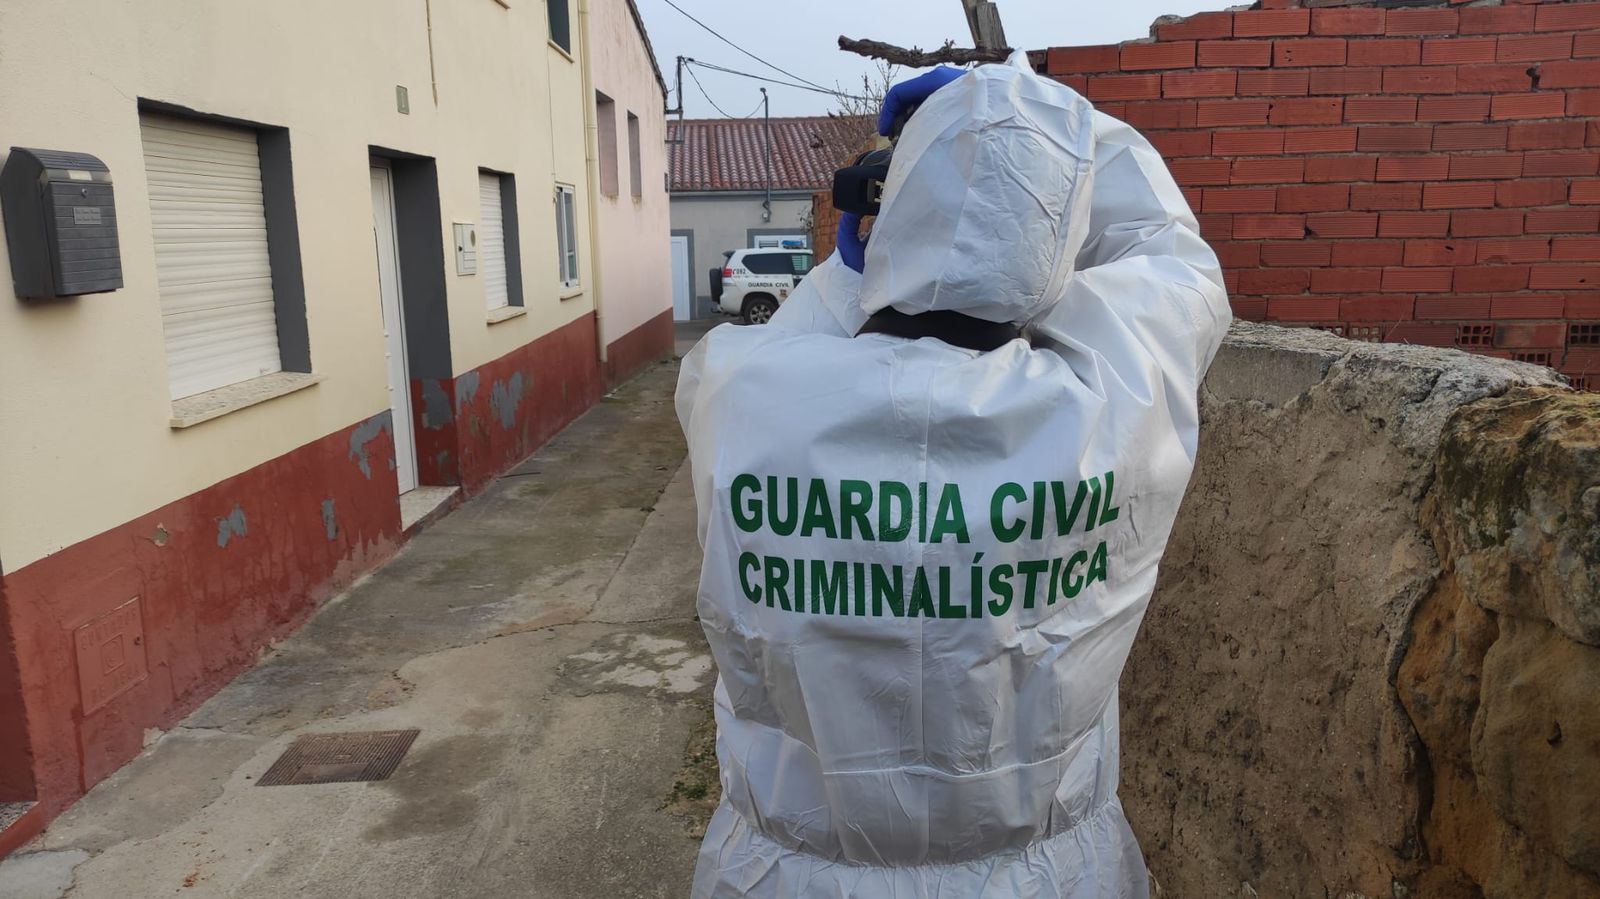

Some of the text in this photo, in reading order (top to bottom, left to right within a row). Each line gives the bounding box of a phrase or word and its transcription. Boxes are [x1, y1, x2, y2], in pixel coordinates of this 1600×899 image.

[730, 470, 1120, 545] GUARDIA CIVIL
[738, 541, 1109, 619] CRIMINALÍSTICA
